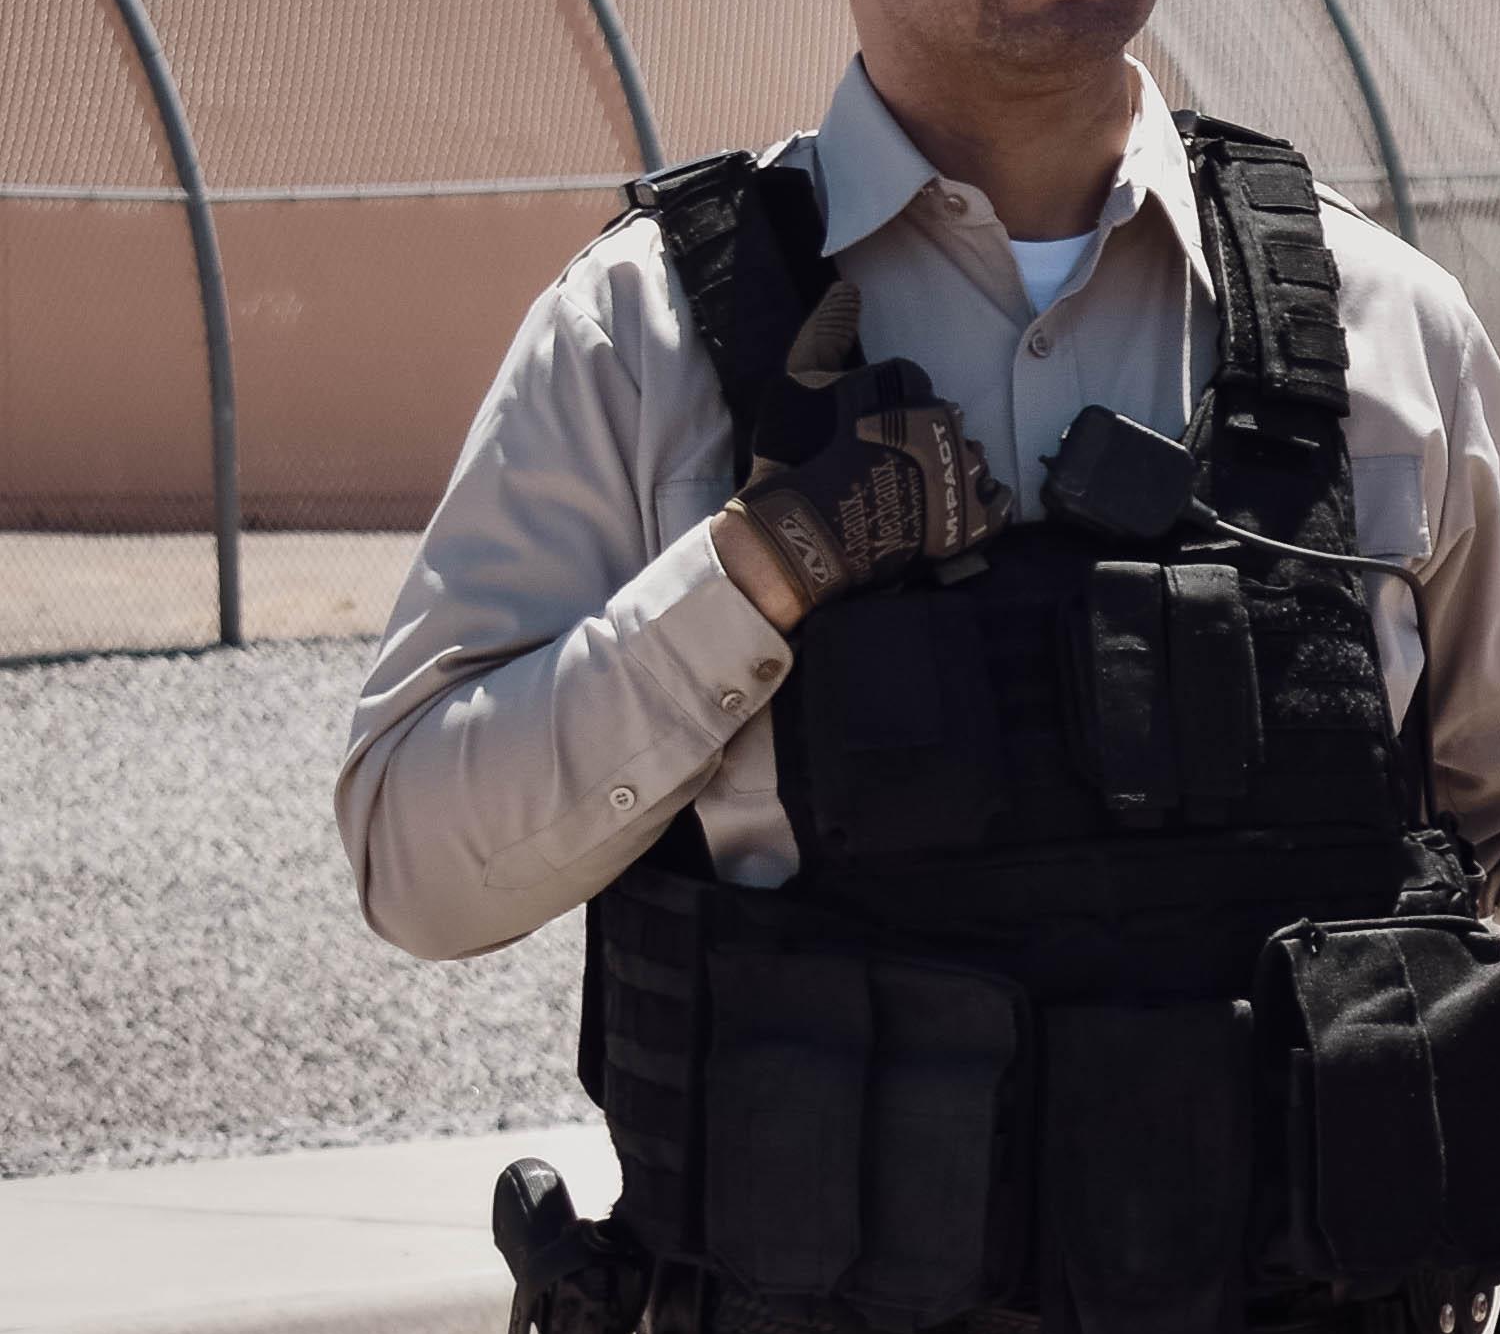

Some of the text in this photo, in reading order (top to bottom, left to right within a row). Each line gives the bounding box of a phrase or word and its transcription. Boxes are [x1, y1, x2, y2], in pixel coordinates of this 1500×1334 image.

[839, 492, 871, 572] echanix
[868, 459, 903, 560] Mechanix
[932, 421, 959, 548] M-PACT
